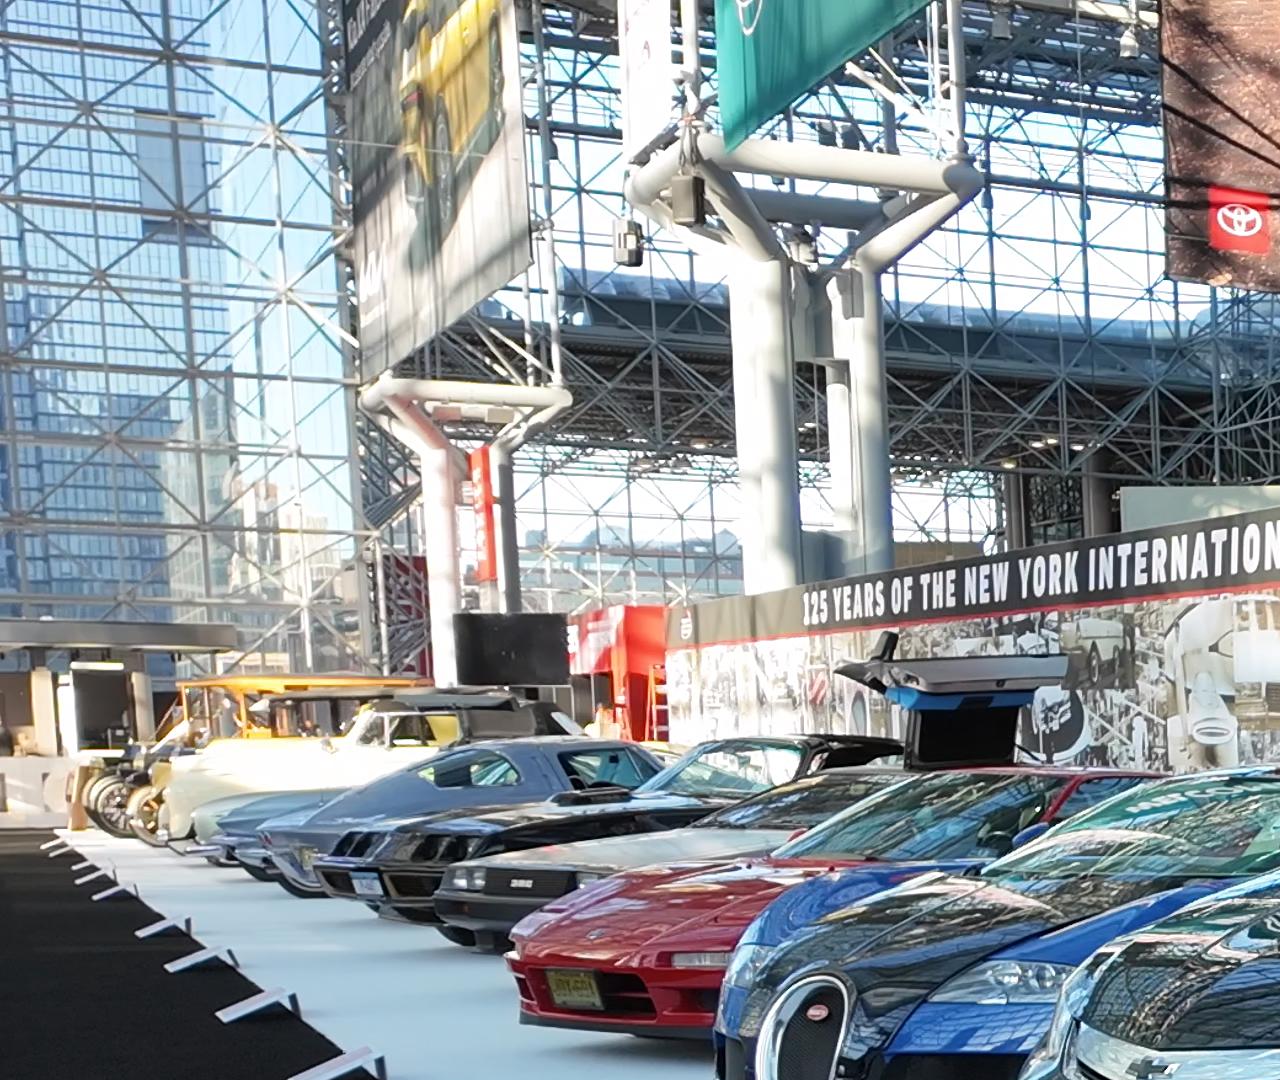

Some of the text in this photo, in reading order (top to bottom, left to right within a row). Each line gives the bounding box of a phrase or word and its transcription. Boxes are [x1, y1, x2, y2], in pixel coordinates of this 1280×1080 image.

[802, 591, 828, 626] 125
[832, 580, 885, 623] YEARS
[891, 575, 913, 615] OF
[920, 568, 957, 611] THE
[964, 560, 1010, 607] NEW
[1018, 550, 1079, 600] YORK
